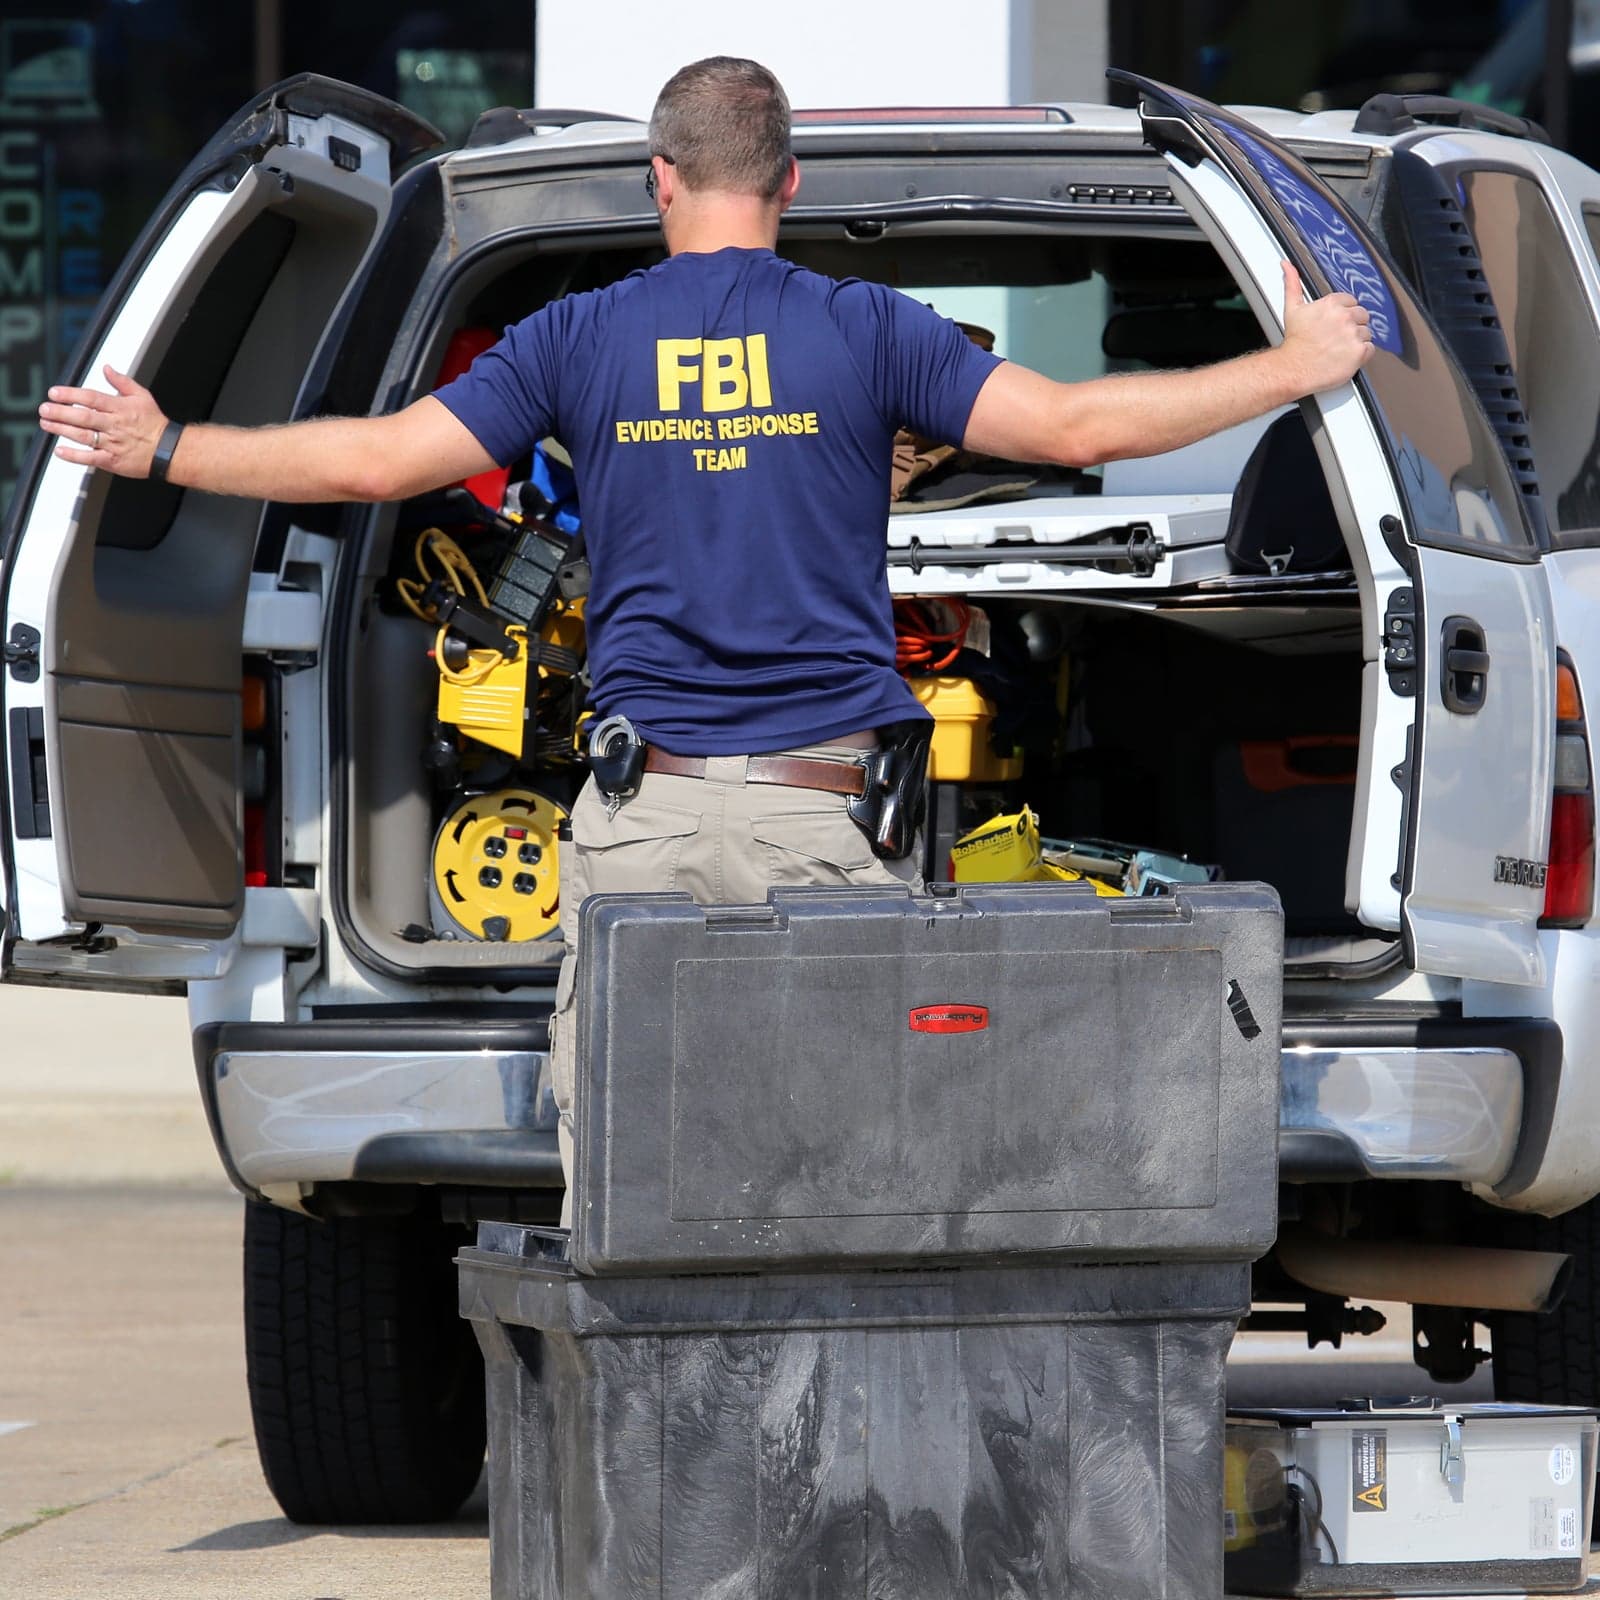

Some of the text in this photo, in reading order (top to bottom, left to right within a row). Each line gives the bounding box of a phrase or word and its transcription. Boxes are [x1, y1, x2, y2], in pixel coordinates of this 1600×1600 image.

[0, 131, 42, 520] COMPUT
[656, 333, 772, 412] FBI
[615, 412, 819, 443] EVIDENCE RESPONSE
[692, 446, 747, 472] TEAM
